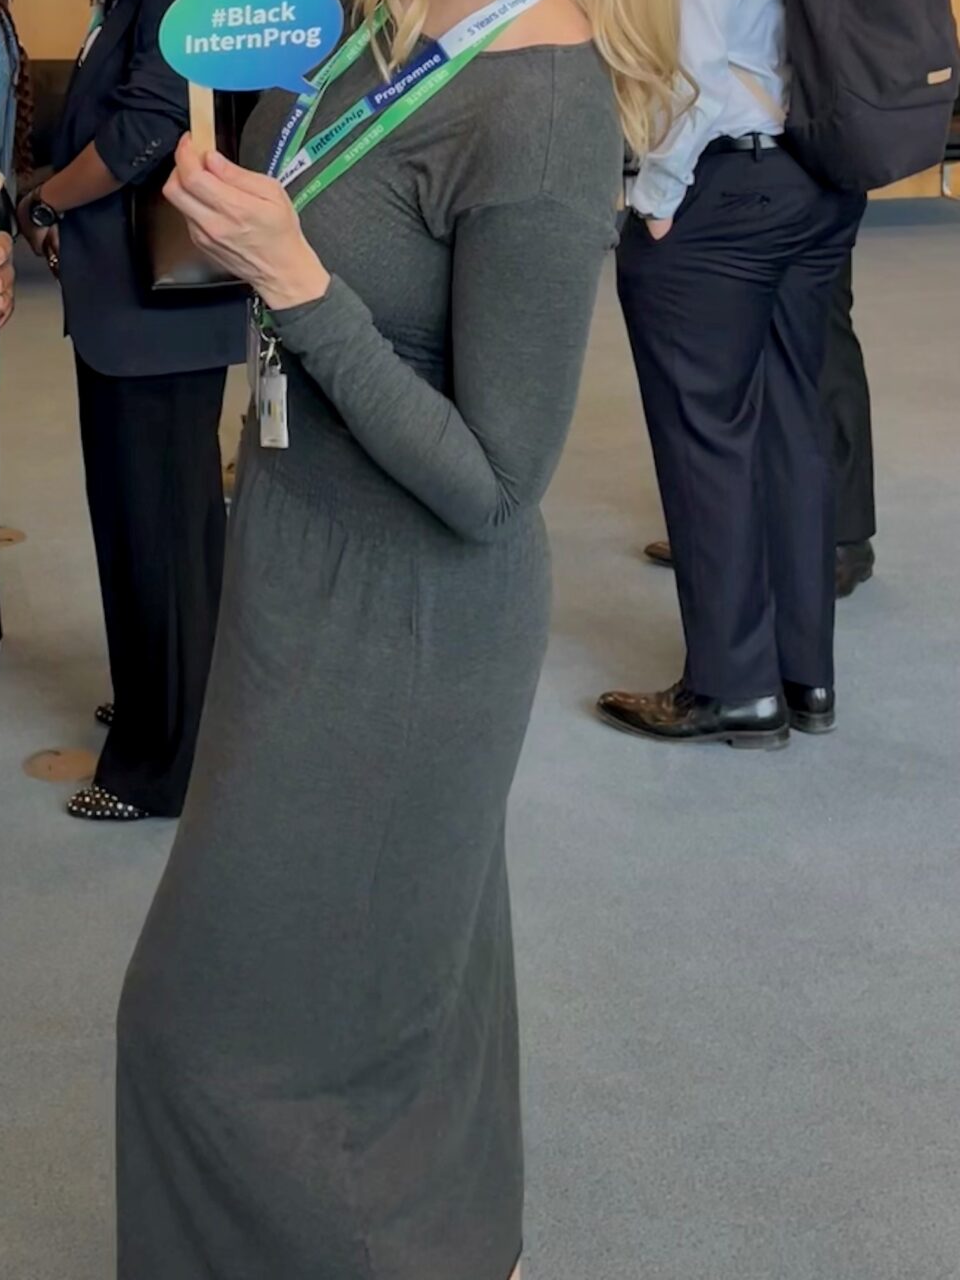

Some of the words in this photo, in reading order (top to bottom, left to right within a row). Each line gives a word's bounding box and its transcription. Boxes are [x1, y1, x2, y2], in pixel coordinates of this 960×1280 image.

[211, 1, 296, 28] #Black
[467, 27, 476, 37] 5
[475, 13, 499, 31] Years
[498, 4, 508, 16] of
[185, 27, 322, 54] InternProg
[311, 108, 364, 154] Internship
[374, 53, 442, 104] Programme
[404, 70, 450, 106] DELEGATE
[344, 124, 384, 161] DELEGATE
